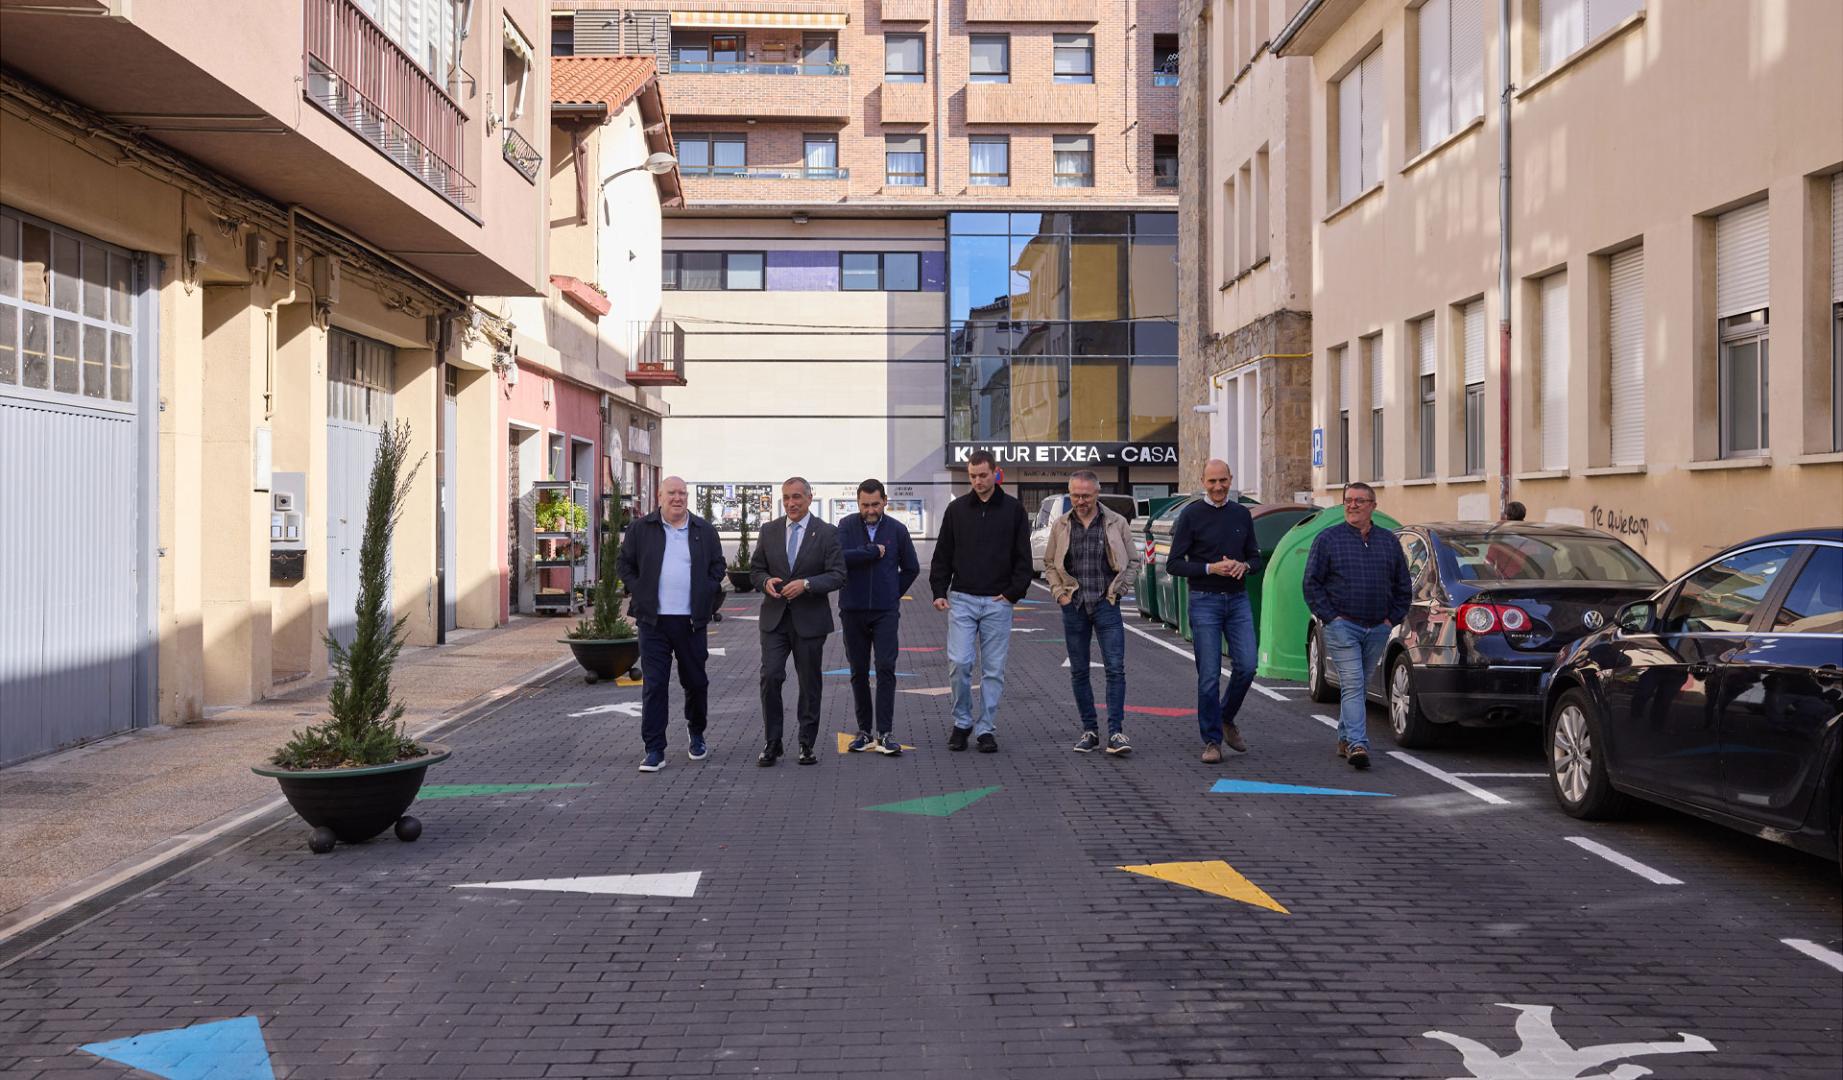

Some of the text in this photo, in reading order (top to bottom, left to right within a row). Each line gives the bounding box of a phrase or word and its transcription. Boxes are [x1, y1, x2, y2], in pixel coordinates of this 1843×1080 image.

[954, 446, 1030, 462] KTUR
[1036, 446, 1101, 462] ETXEA
[1121, 446, 1178, 462] CASA
